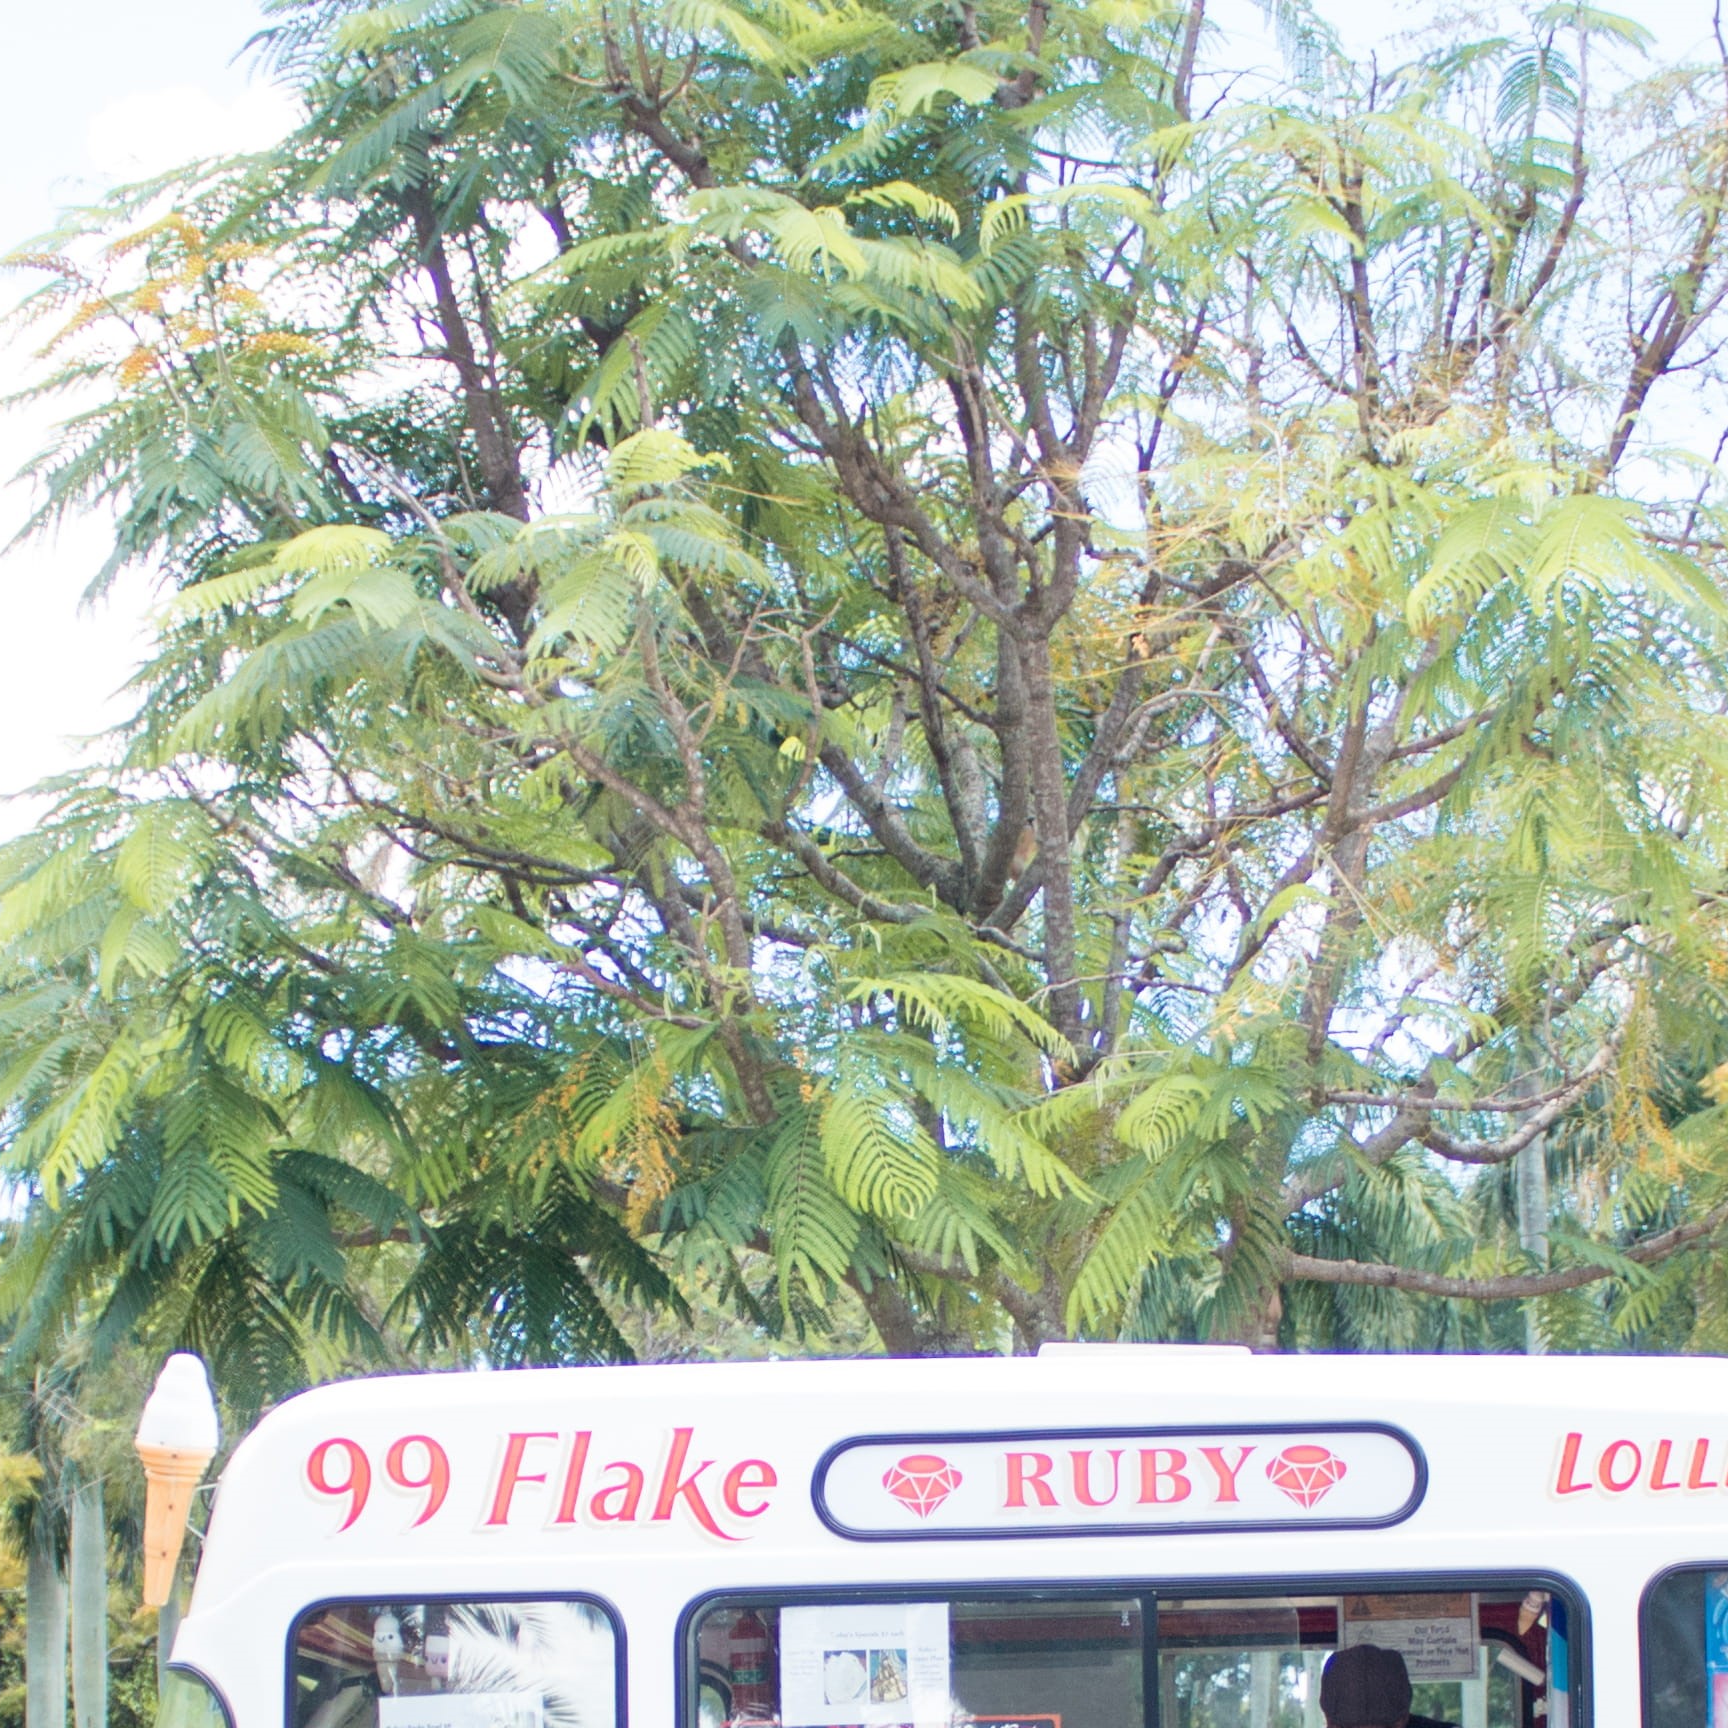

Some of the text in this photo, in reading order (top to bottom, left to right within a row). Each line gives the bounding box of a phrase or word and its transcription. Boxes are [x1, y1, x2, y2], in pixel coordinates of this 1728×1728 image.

[306, 1426, 778, 1541] 99 Flake
[1001, 1445, 1258, 1509] RUBY
